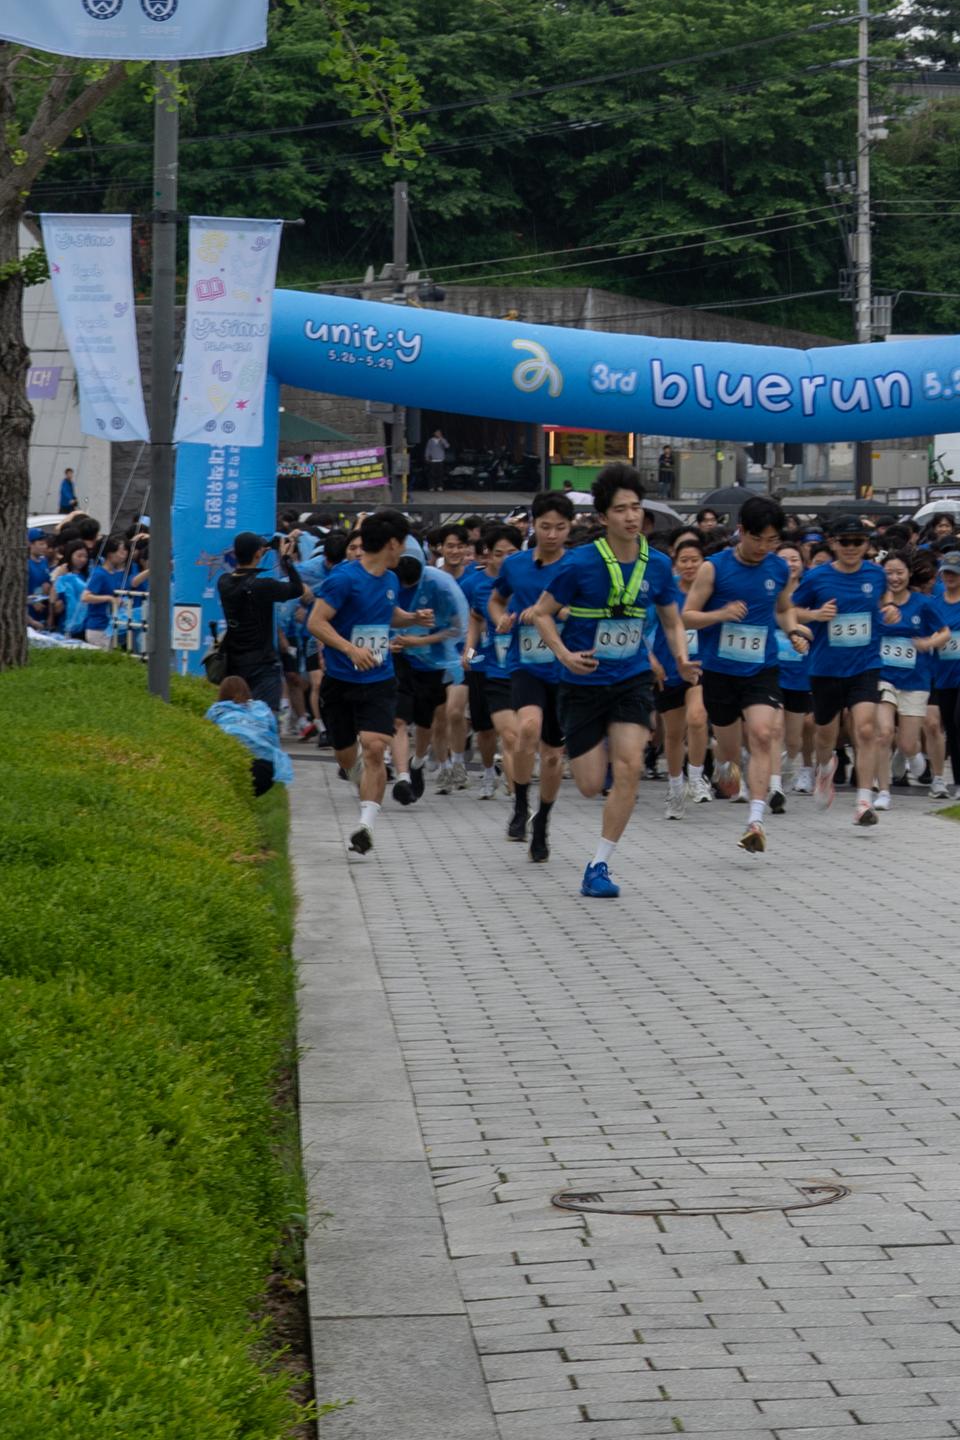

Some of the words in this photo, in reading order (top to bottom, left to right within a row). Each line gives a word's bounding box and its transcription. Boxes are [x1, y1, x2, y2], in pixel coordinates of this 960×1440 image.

[304, 318, 422, 363] unit:y
[591, 361, 637, 394] 3rd
[649, 358, 912, 416] bluerun
[204, 444, 226, 529] 대책위원회
[600, 629, 640, 647] 000
[832, 623, 868, 637] 351
[355, 636, 388, 649] 012
[523, 637, 550, 652] 04
[727, 633, 761, 650] 118
[882, 644, 914, 659] 338
